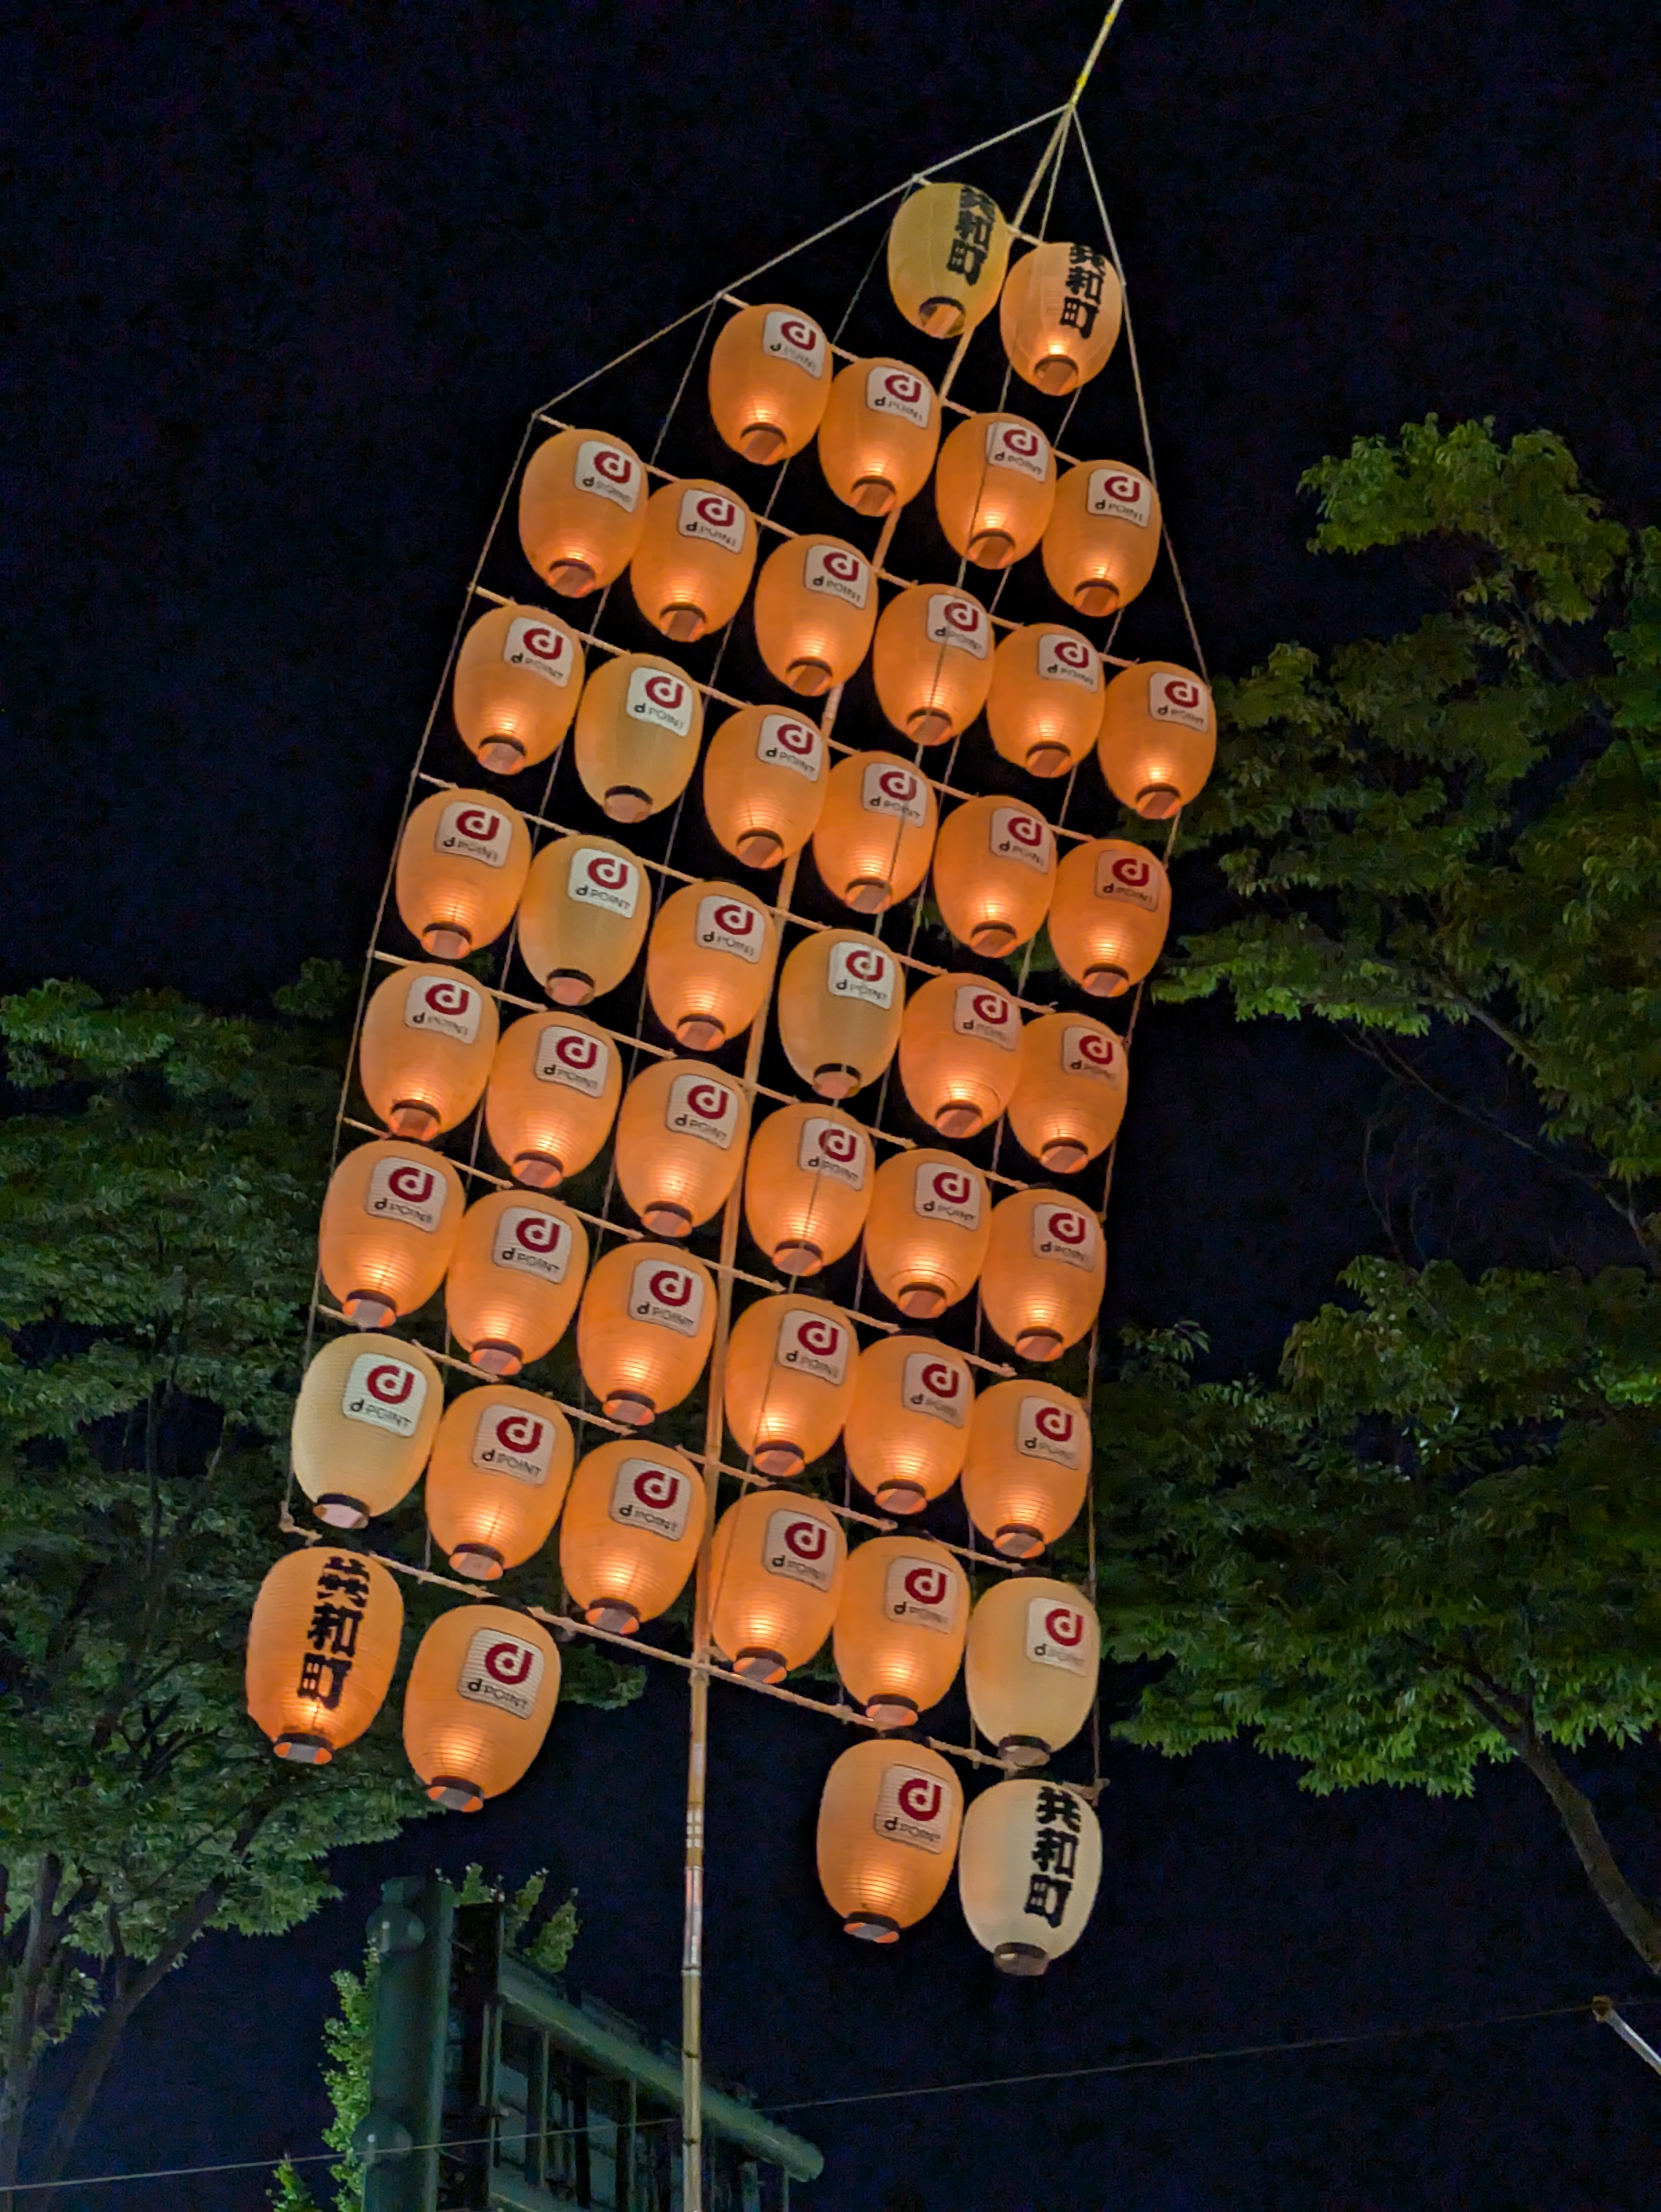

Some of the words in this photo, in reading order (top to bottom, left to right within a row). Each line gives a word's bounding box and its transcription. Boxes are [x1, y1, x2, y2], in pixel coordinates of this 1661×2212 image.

[1060, 243, 1105, 339] 共和町
[297, 1556, 370, 1710] 共和町
[1024, 1786, 1081, 1928] 共和町
